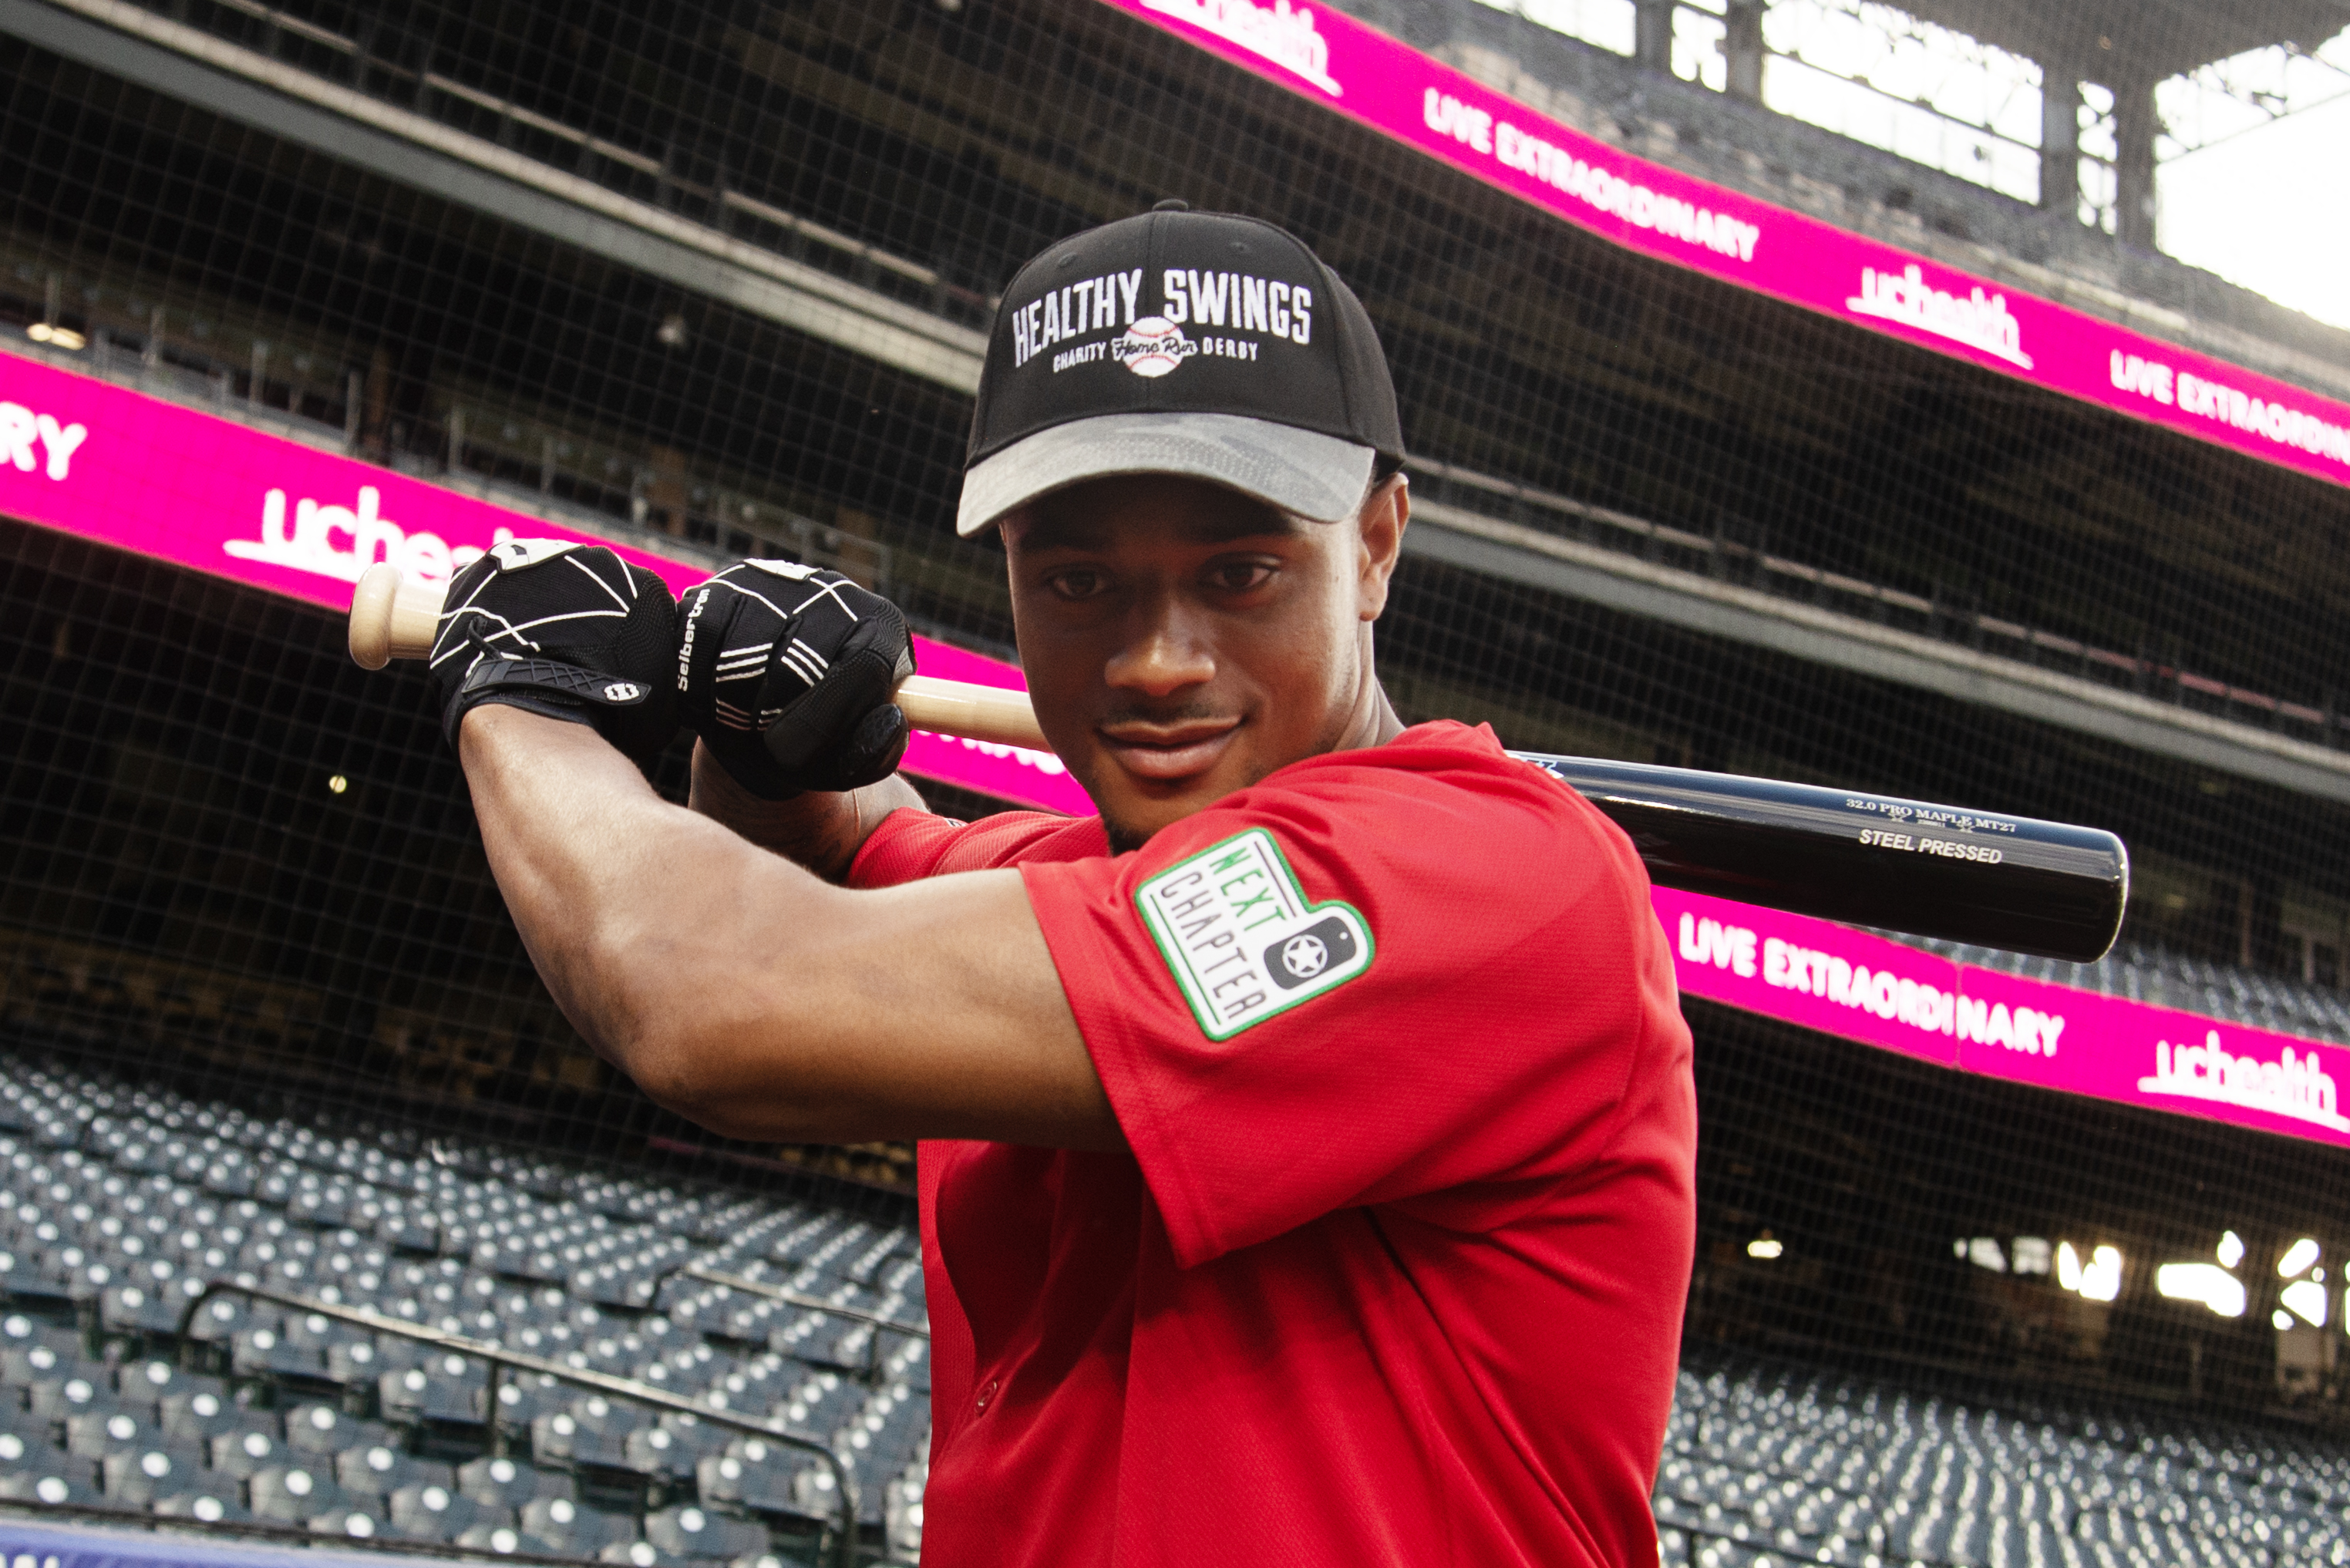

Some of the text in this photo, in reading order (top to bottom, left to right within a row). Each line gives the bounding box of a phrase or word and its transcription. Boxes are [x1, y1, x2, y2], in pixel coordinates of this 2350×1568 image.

[1423, 87, 1759, 262] LIVE EXTRAORDINARY
[1012, 268, 1312, 368] HEALTHY SWINGS
[1052, 336, 1258, 373] CHARITY Home Run DERBY
[1857, 264, 2025, 361] uchealth
[2109, 348, 2174, 405] LIVE
[678, 587, 711, 692] Selbertron
[1846, 798, 1877, 812] 32.0
[1879, 802, 1913, 816] PRO
[1915, 808, 1972, 827] MAPLE
[1975, 817, 2017, 833] MT27
[1859, 829, 2003, 864] STEEL PRESSED
[1208, 846, 1287, 932] NEXT
[1160, 870, 1267, 1020] CHAPTER
[1678, 912, 2066, 1058] LIVE EXTRAORDINARY
[2150, 1029, 2342, 1122] uchealth
